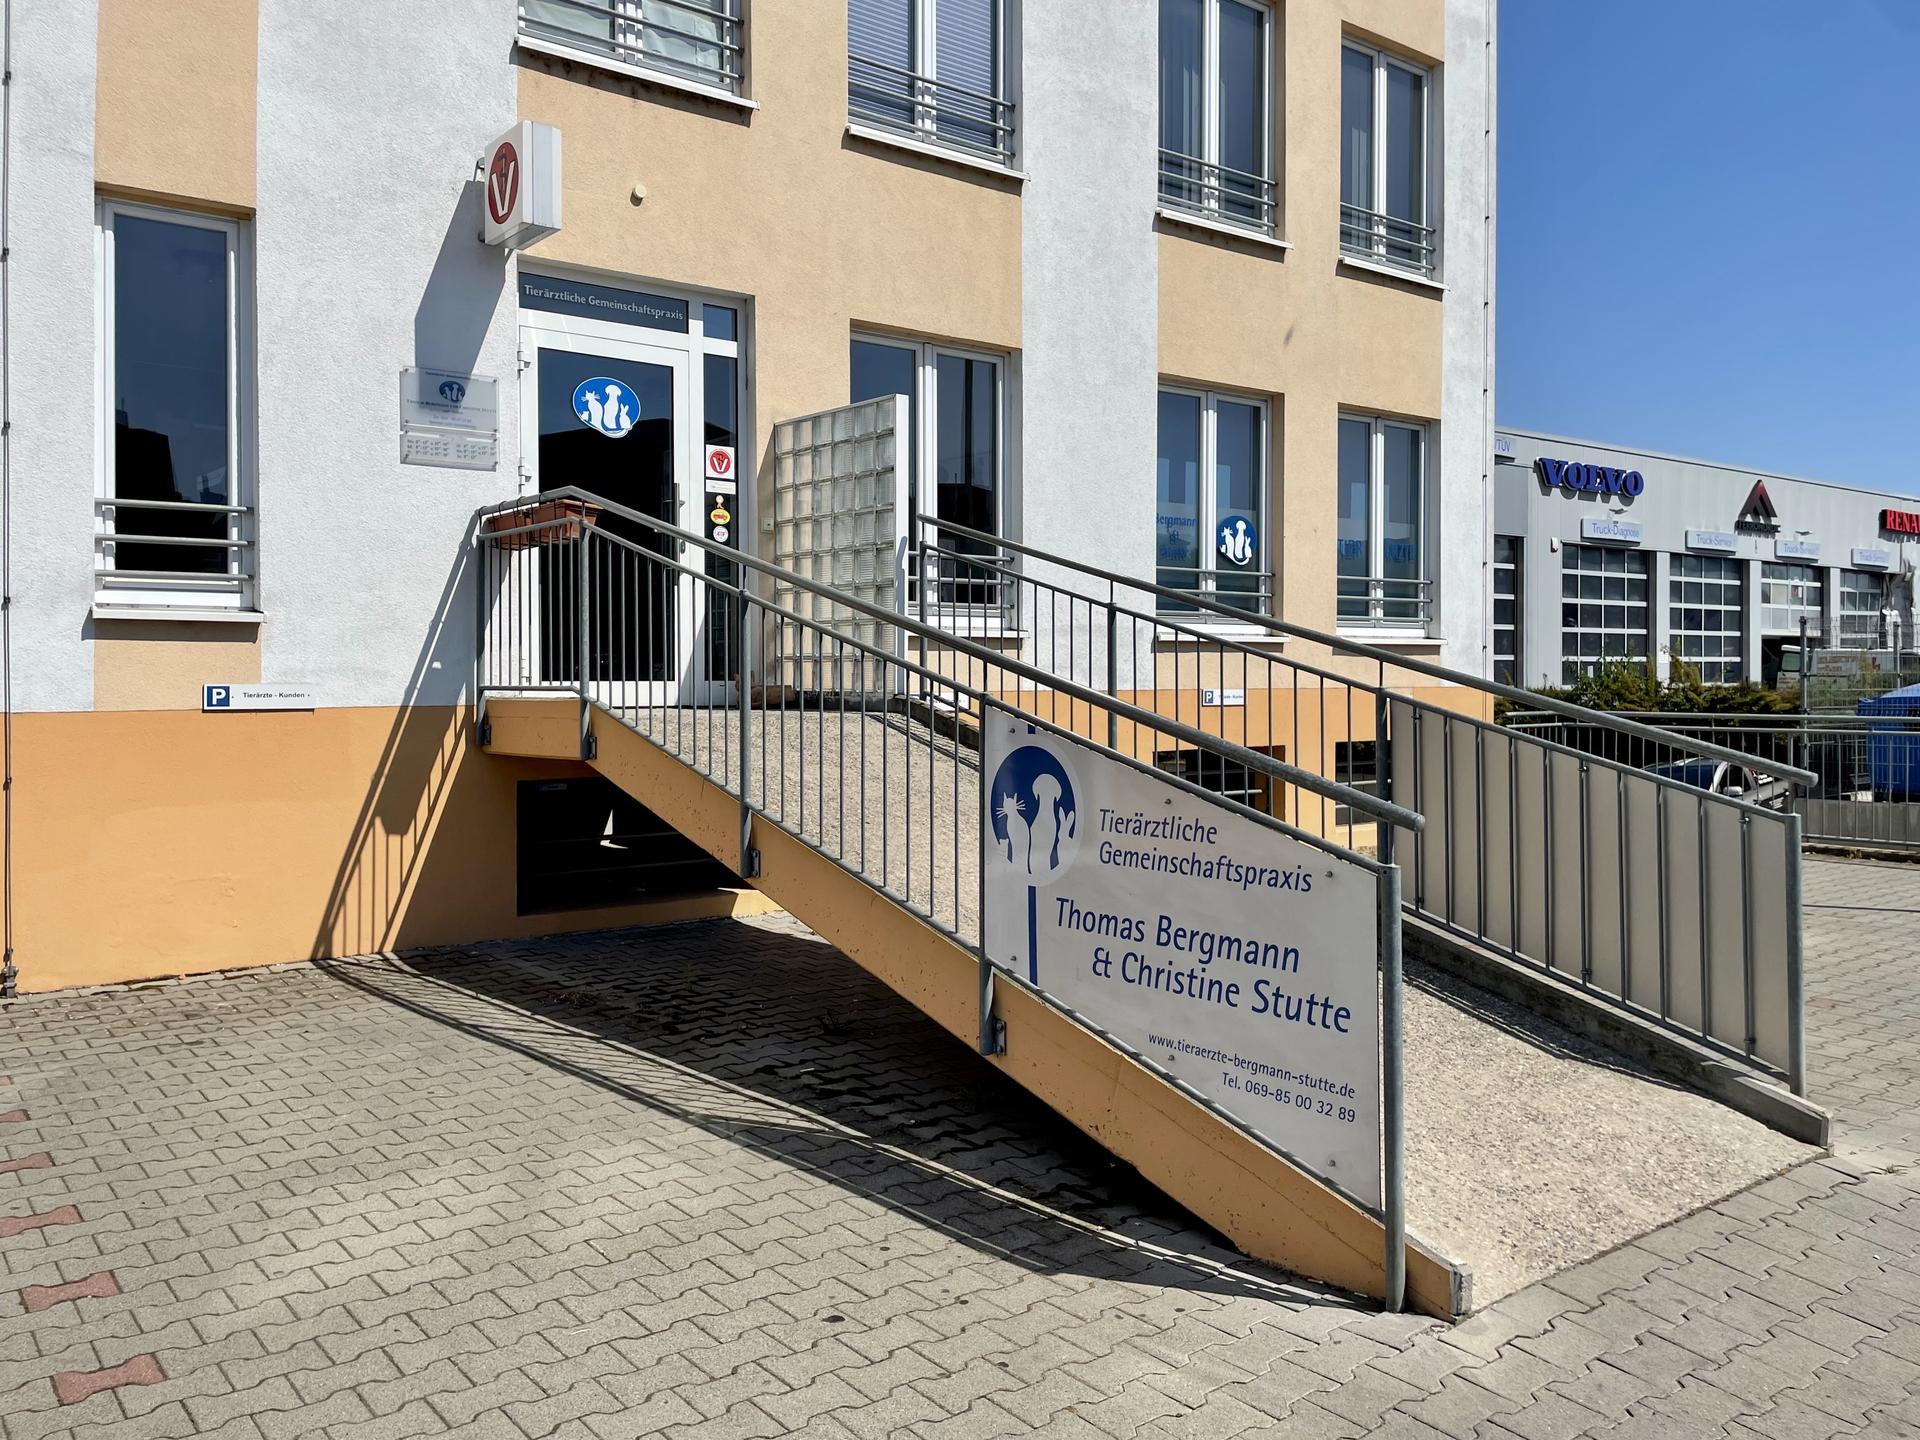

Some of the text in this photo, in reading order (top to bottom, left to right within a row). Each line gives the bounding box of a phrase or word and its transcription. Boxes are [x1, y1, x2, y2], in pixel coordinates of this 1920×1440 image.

[524, 284, 684, 320] Tierärztliche Gemeinschaftspraxis
[1539, 457, 1644, 497] VOLVO
[1885, 508, 1920, 534] RENA
[211, 688, 227, 705] P
[1099, 808, 1218, 845] Tierärztliche
[1099, 841, 1313, 892] Gemeinschaftspraxis
[1055, 897, 1300, 973] Thomas Bergmann
[1091, 947, 1351, 1033] & Christine Stutte
[1148, 1033, 1355, 1099] www.tieraerzte-bergmann-stutte.de
[1222, 1071, 1355, 1123] Tel. 069-85 00 32 89
